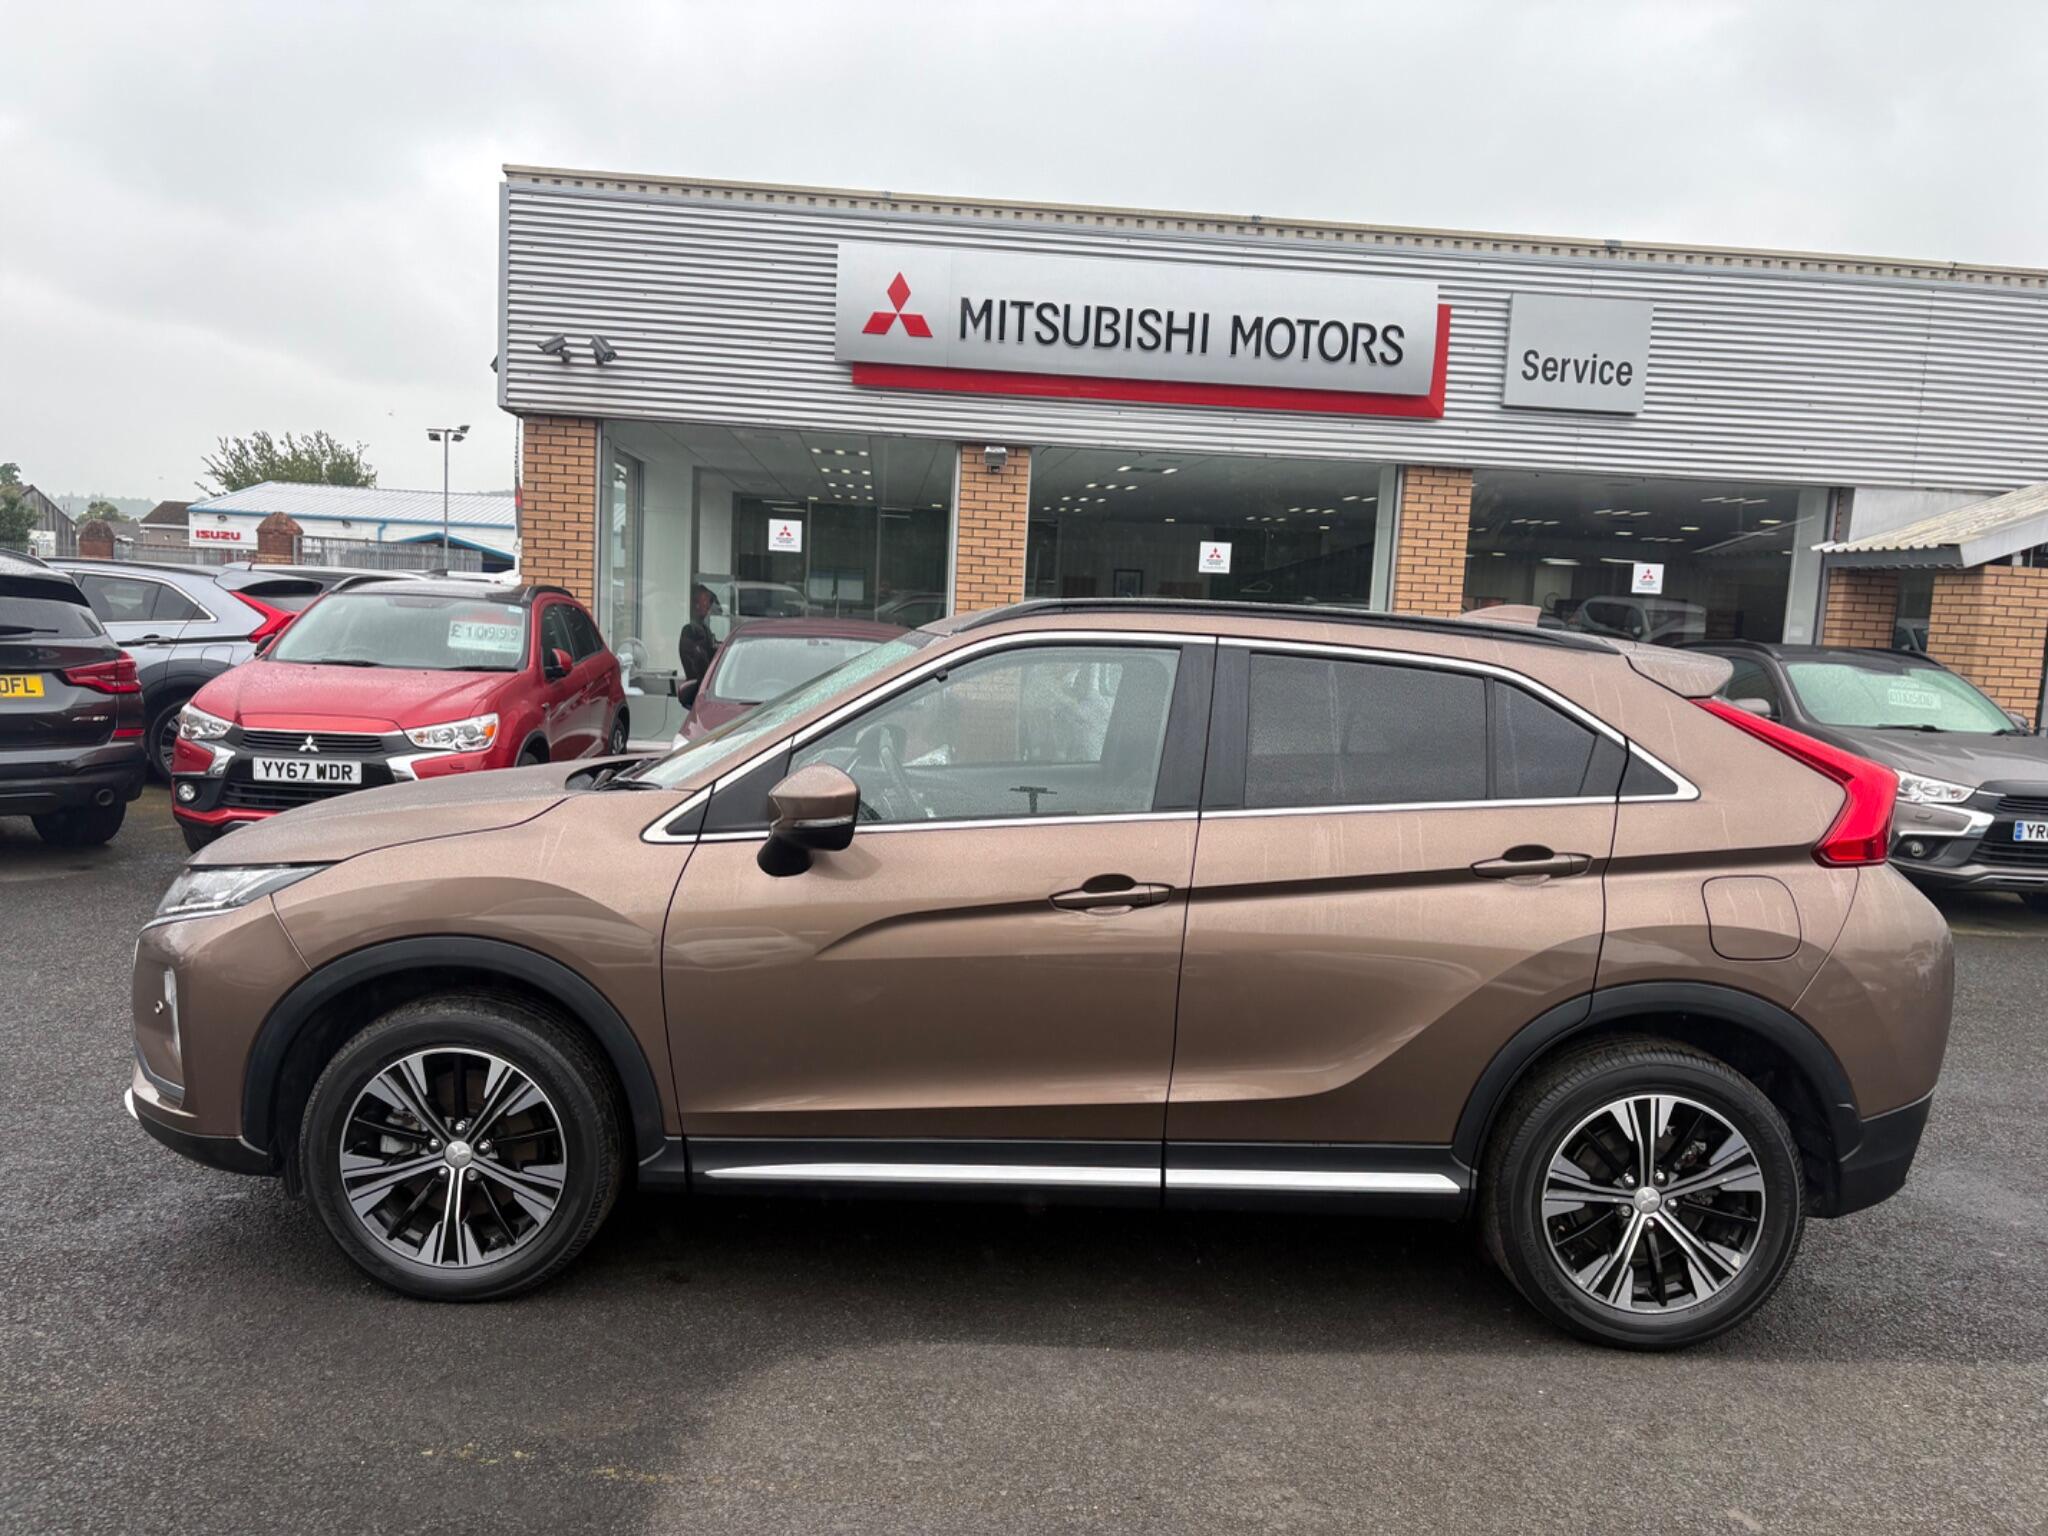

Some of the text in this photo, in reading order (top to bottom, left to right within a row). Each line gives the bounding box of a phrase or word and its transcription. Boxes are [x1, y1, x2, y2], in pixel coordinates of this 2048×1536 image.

[959, 297, 1405, 366] MITSUBISHI MOTORS
[1521, 349, 1633, 386] Service
[195, 529, 241, 541] ISUZU
[262, 761, 353, 781] YY67 WDR
[2027, 823, 2048, 839] YR
